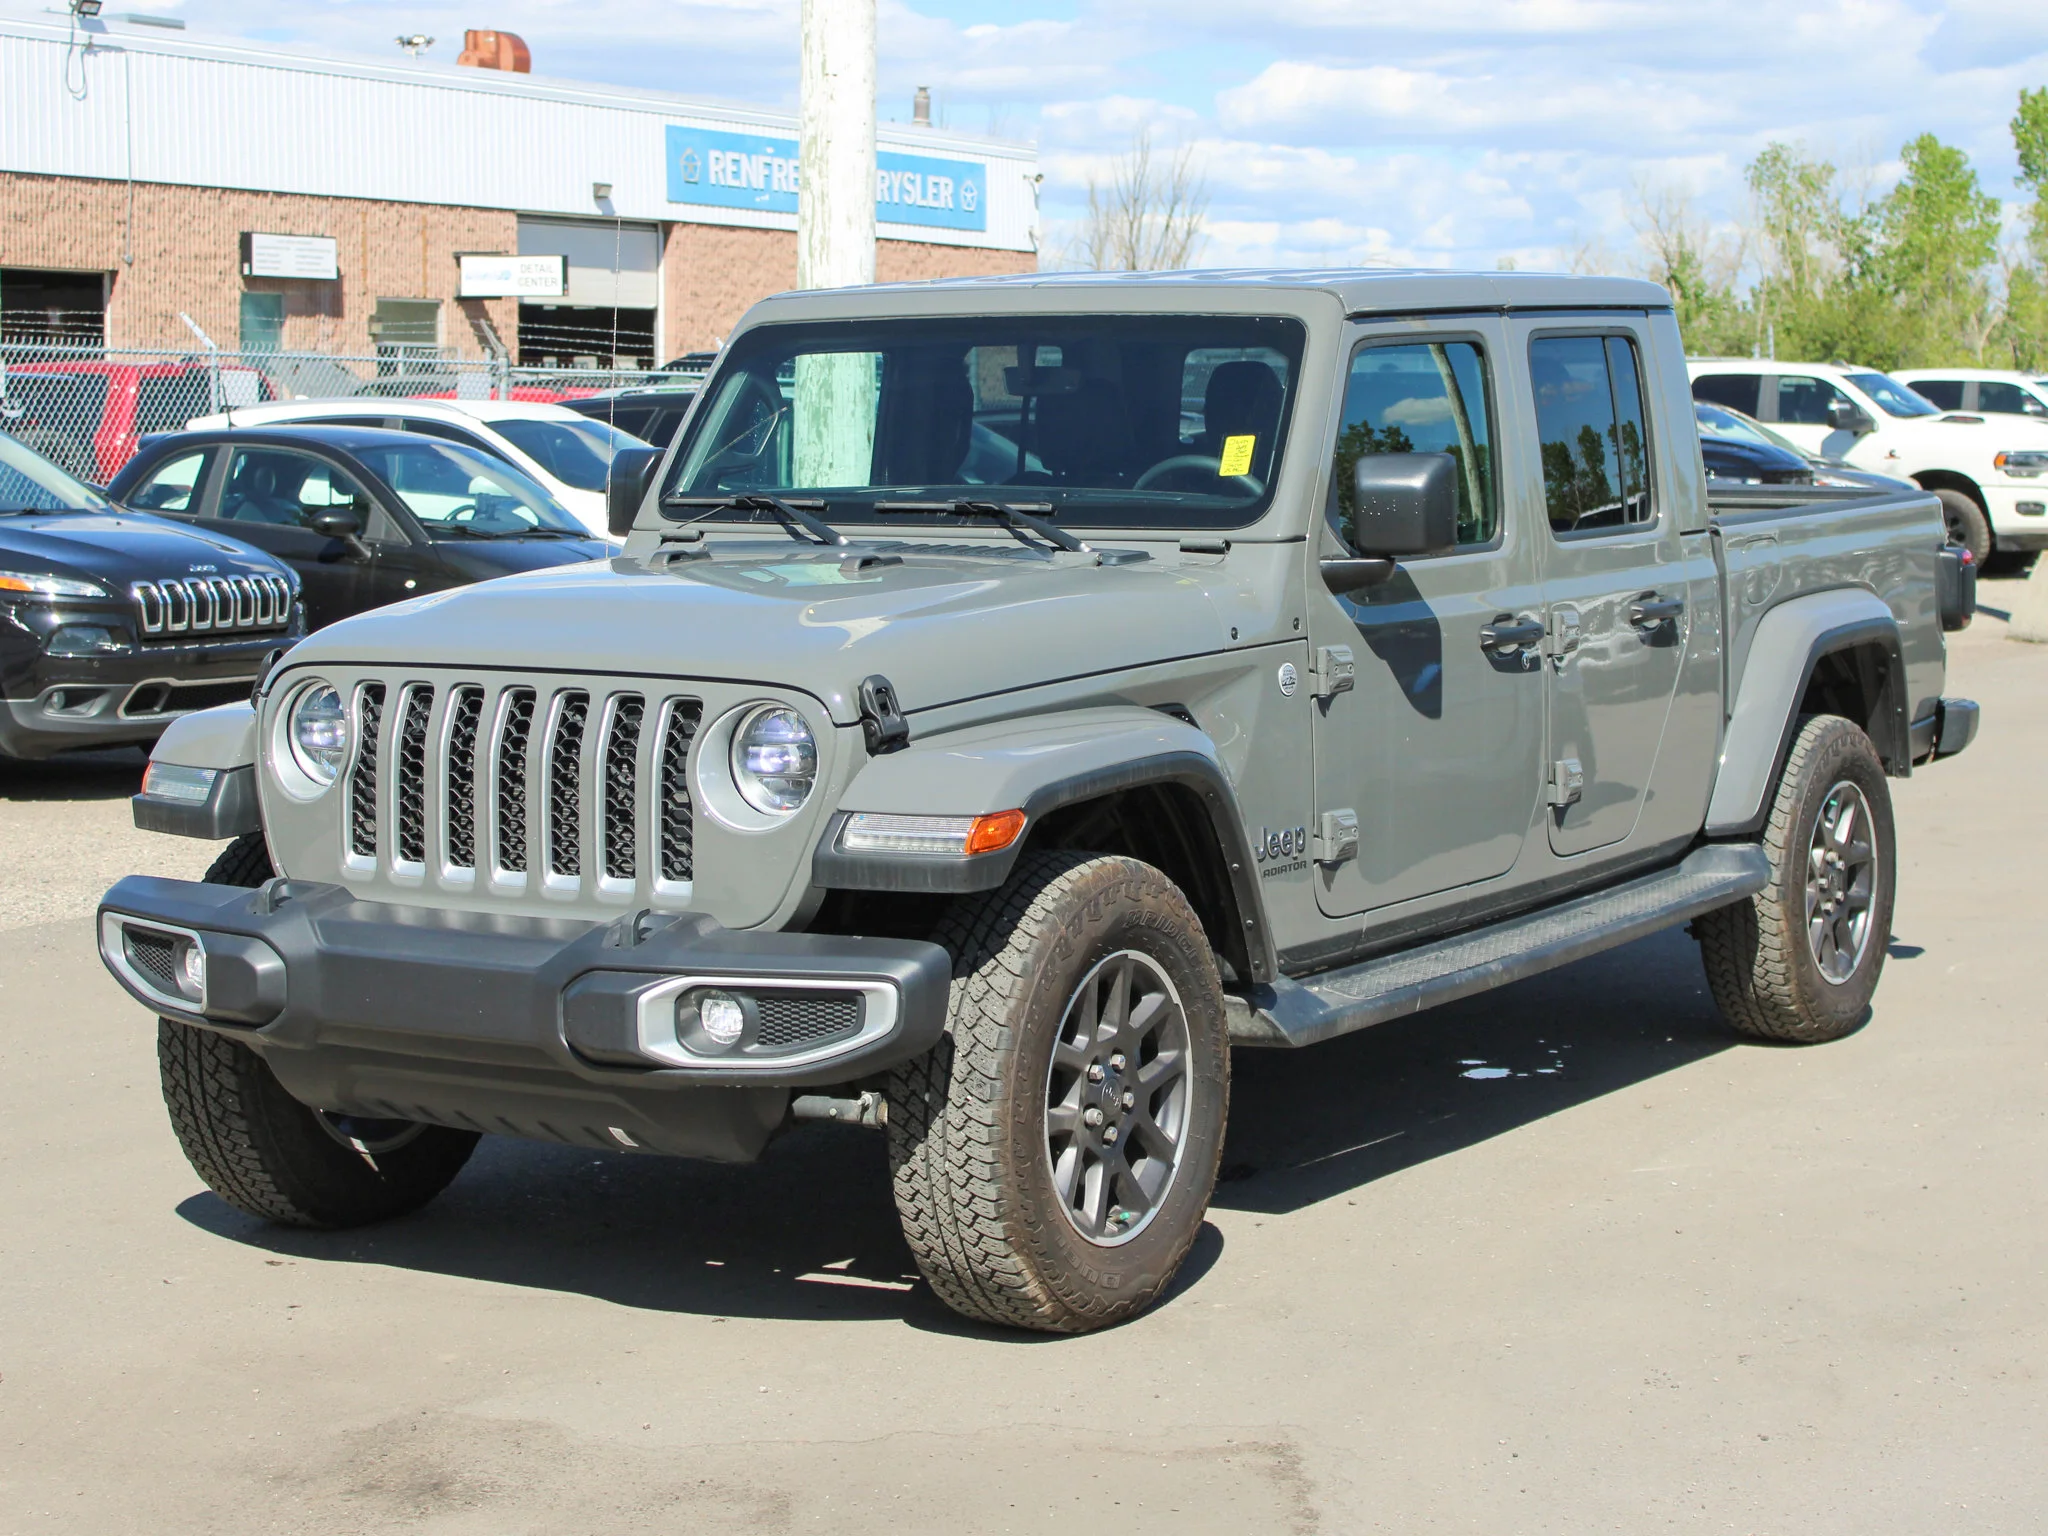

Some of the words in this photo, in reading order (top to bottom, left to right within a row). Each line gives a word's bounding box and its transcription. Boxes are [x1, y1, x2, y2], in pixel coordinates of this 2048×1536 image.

[708, 149, 799, 195] RENFRE
[876, 169, 954, 211] RYSLER
[520, 263, 554, 274] DETAIL
[517, 277, 558, 287] CENTER
[1254, 826, 1306, 863] Jeep
[1262, 860, 1307, 878] ADIATOR
